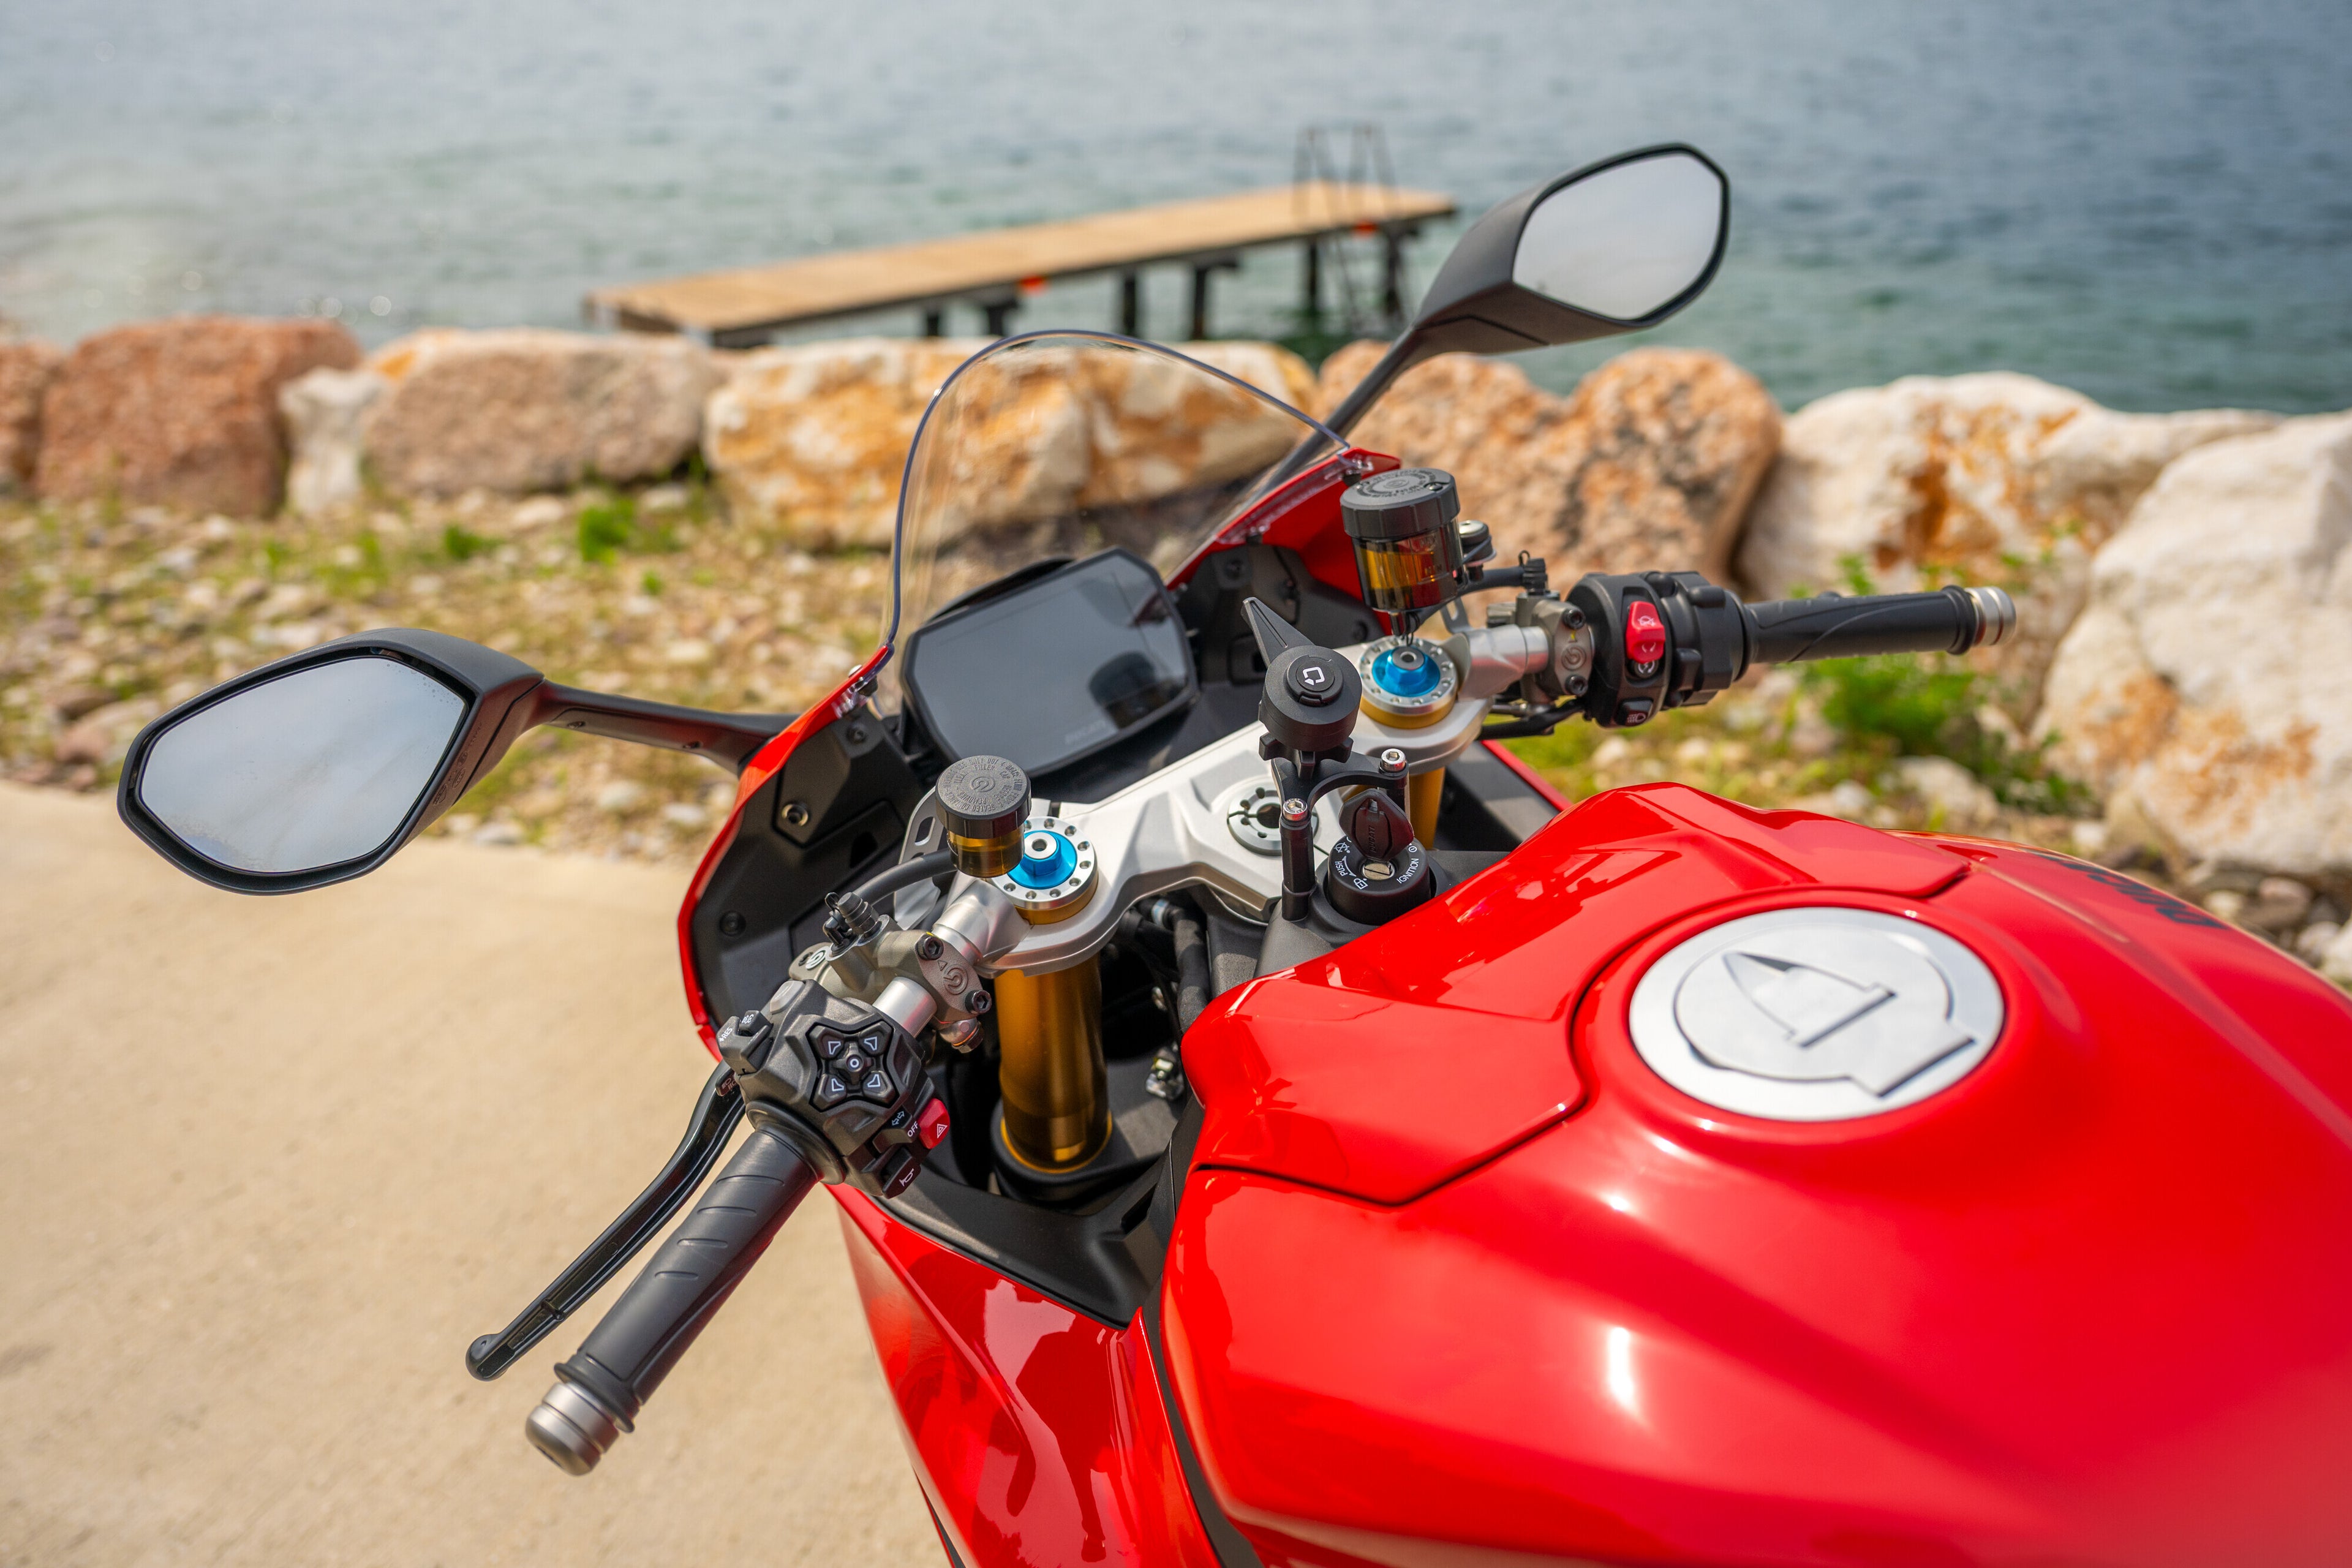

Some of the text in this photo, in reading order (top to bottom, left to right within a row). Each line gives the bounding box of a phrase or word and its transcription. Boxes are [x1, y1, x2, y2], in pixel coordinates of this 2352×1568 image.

[1335, 861, 1348, 876] PUSH
[1396, 858, 1419, 884] IGNITION
[907, 1121, 918, 1137] OFF
